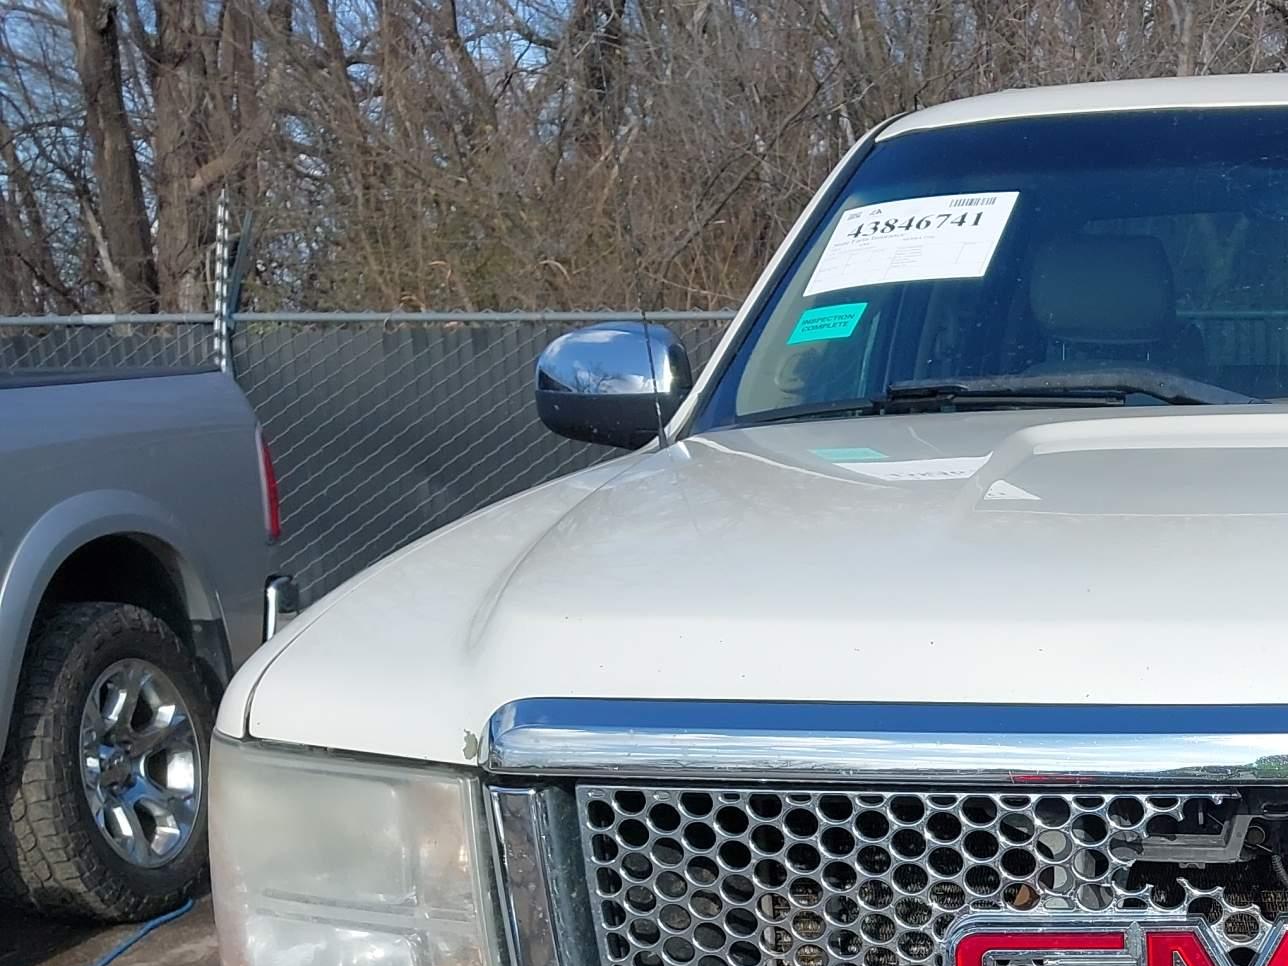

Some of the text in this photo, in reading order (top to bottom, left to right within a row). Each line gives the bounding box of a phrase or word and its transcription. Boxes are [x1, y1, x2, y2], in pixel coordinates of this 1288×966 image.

[847, 211, 985, 238] 43846741
[801, 312, 855, 326] INSPECTION
[801, 321, 849, 333] COMPLETE
